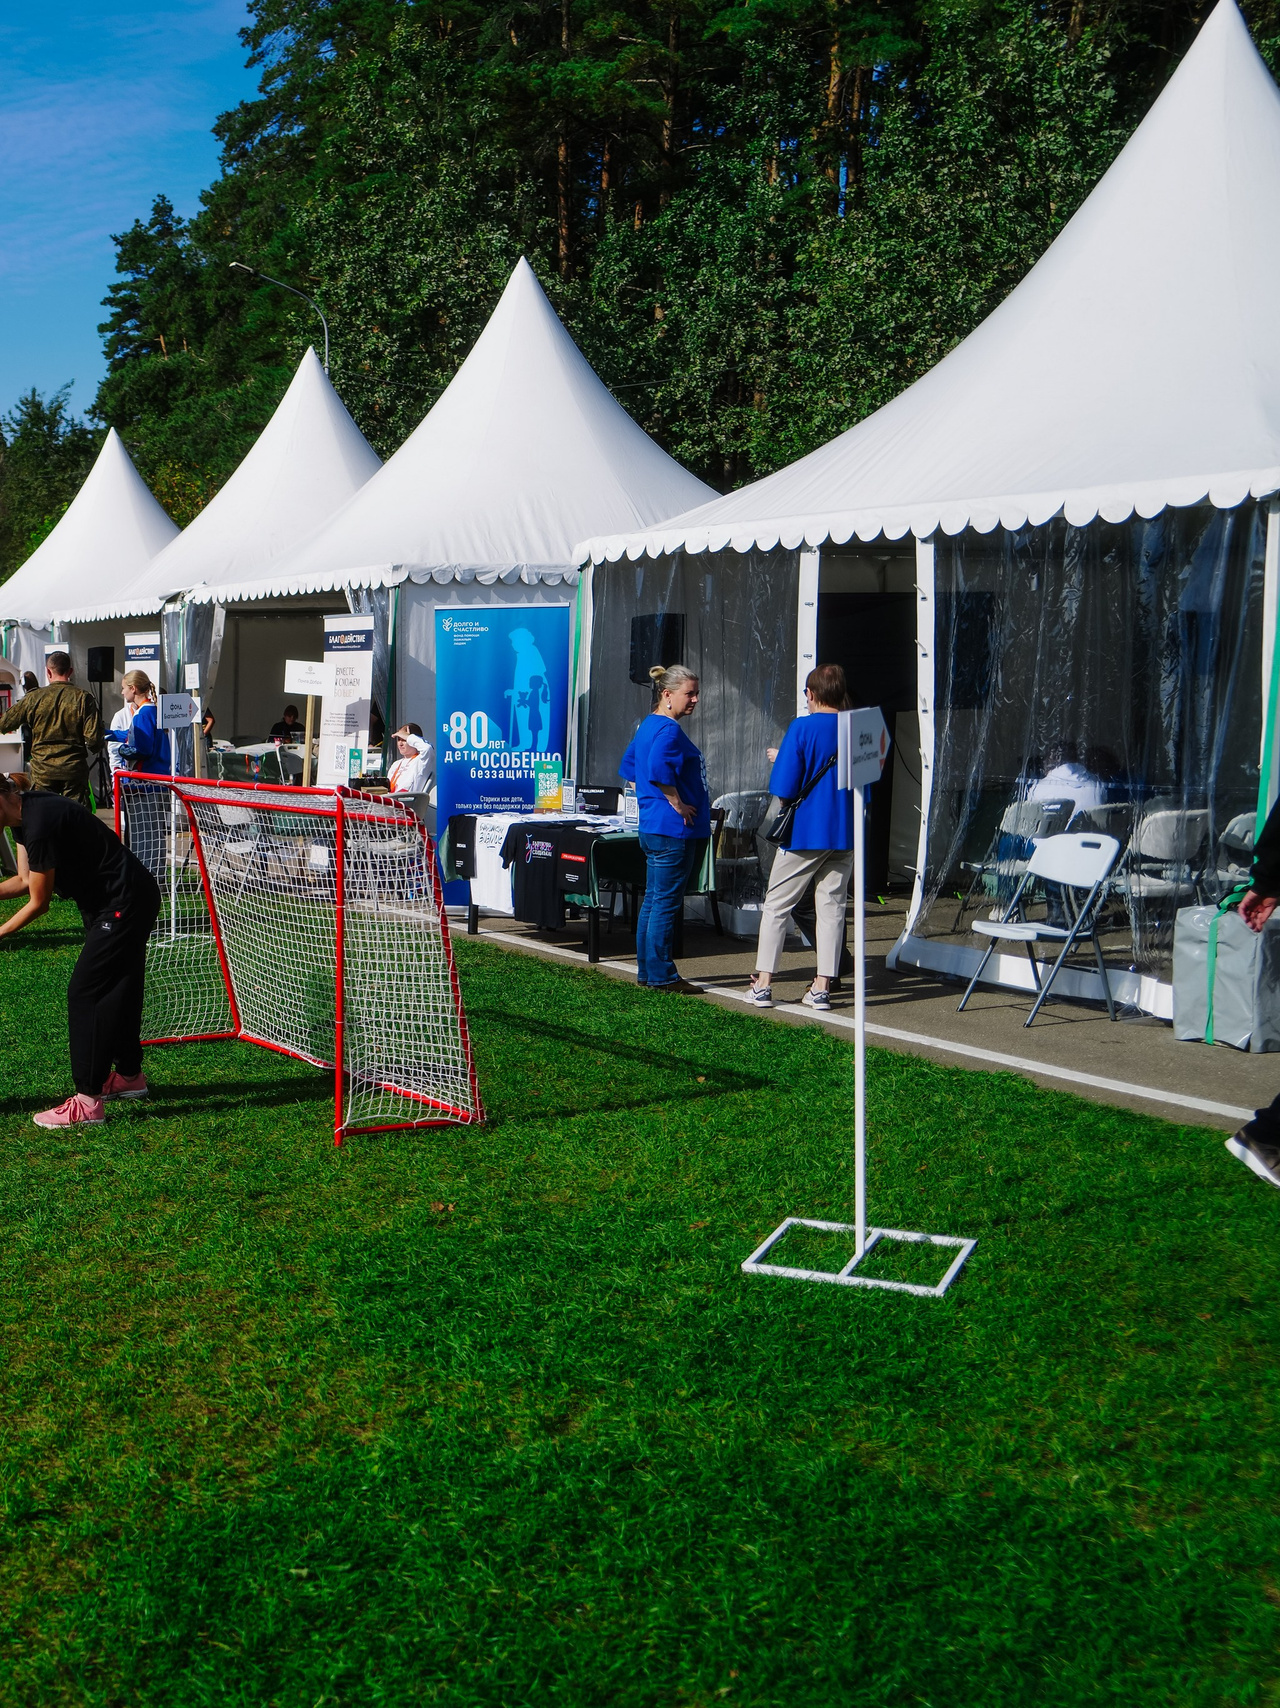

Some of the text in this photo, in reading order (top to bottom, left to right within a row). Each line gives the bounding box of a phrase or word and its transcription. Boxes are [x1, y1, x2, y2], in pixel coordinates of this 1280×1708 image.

[449, 710, 489, 749] 80
[488, 740, 506, 750] лет
[444, 750, 478, 764] дети
[470, 768, 535, 780] беззащитн
[479, 795, 501, 803] Старики
